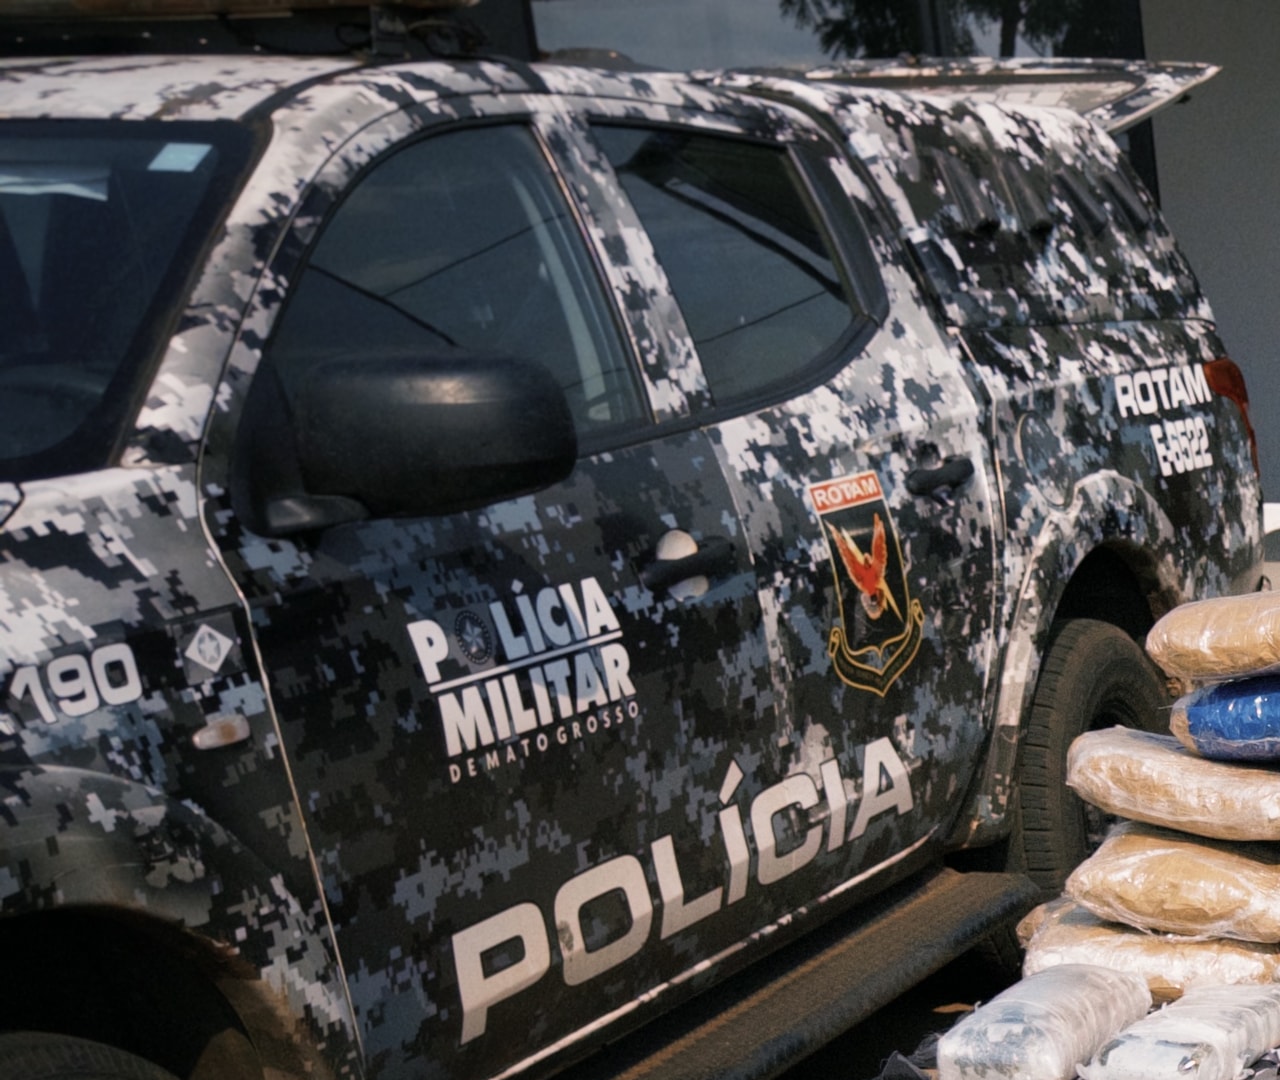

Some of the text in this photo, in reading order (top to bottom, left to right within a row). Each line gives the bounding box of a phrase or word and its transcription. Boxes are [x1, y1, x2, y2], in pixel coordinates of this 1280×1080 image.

[1114, 363, 1212, 418] ROTAM
[814, 477, 877, 507] ROTAM
[10, 643, 142, 724] 190
[438, 643, 636, 758] MILITAR
[449, 700, 639, 784] DE MATO GROSSO
[452, 736, 914, 1045] POLÍCIA
